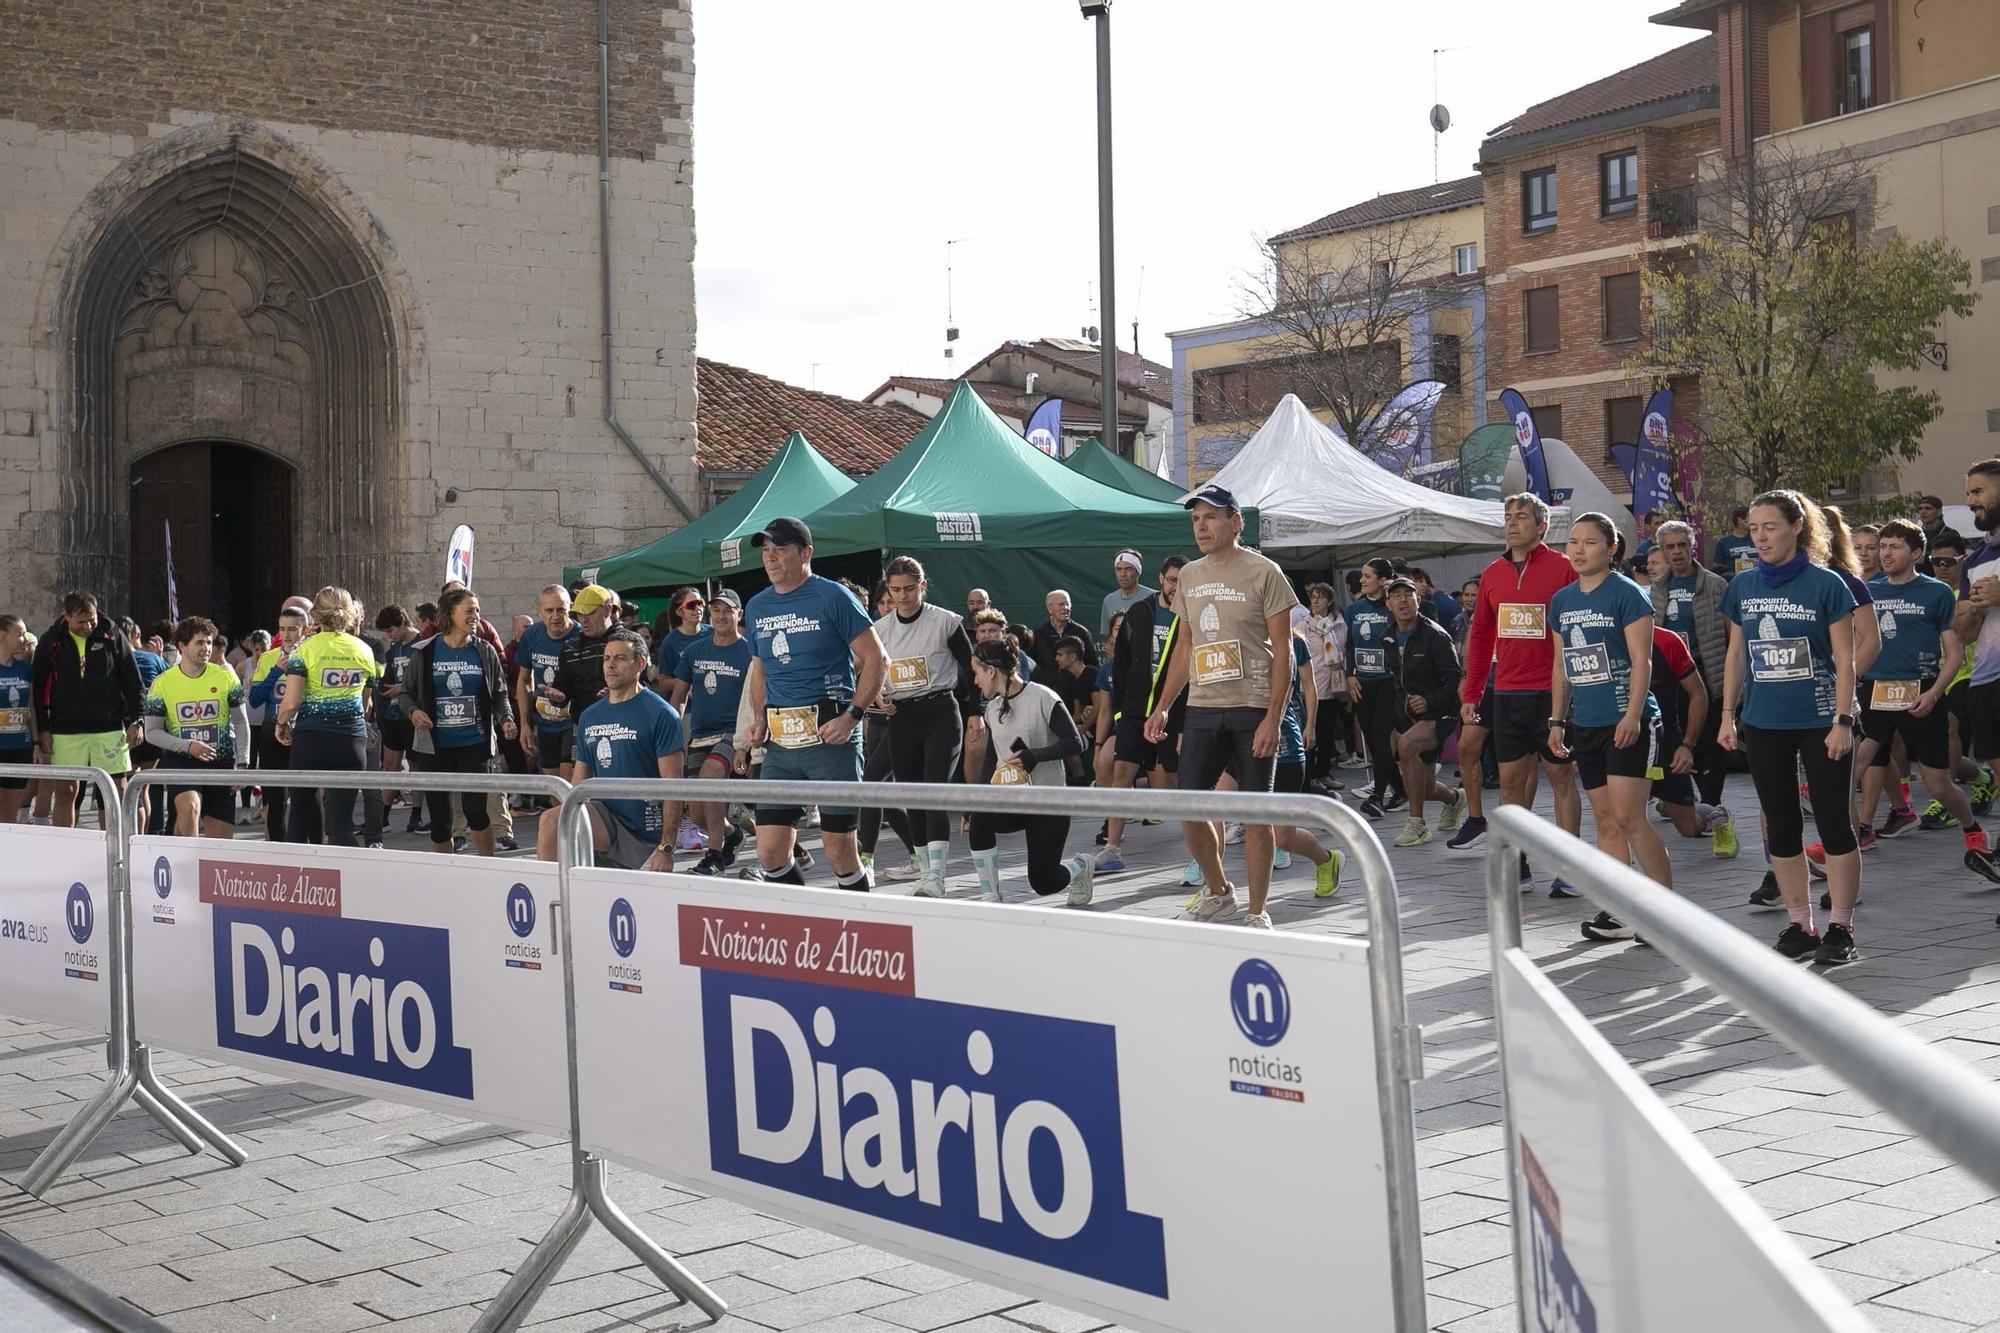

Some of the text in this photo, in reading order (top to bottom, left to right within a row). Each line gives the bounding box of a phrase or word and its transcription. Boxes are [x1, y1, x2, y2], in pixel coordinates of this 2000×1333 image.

[936, 522, 974, 534] GASTEIZ
[1195, 588, 1236, 599] ALMENDRA
[1748, 597, 1790, 606] CONQUISTA
[1748, 603, 1805, 614] ALMENDRA
[756, 612, 797, 625] LA CONQUISTA
[1510, 612, 1533, 626] 326
[1561, 613, 1604, 625] ALMENDRA
[1775, 612, 1817, 622] KONKISTA
[1894, 608, 1926, 616] KONKISTA
[763, 616, 810, 632] ALMENDRA
[787, 624, 821, 634] KONKISTA
[1206, 651, 1227, 668] 474
[1571, 655, 1599, 672] 1033
[1761, 648, 1797, 666] 1037
[896, 664, 916, 679] 708
[1887, 686, 1906, 699] 617
[445, 704, 465, 716] 832
[9, 712, 23, 724] 321
[590, 727, 629, 737] ALMENDRA
[780, 717, 805, 734] 133
[190, 730, 211, 741] 949
[1001, 768, 1018, 784] 709
[212, 866, 337, 907] Noticias de Álava
[1, 918, 48, 944] ava.eus
[505, 942, 541, 959] noticias
[700, 917, 906, 981] Noticias de Álava
[64, 949, 98, 968] noticias
[608, 962, 642, 981] noticias
[230, 921, 436, 1069] Diario
[1229, 1054, 1302, 1083] noticias
[1236, 1082, 1261, 1095] GRUPO
[730, 994, 1093, 1240] Diario
